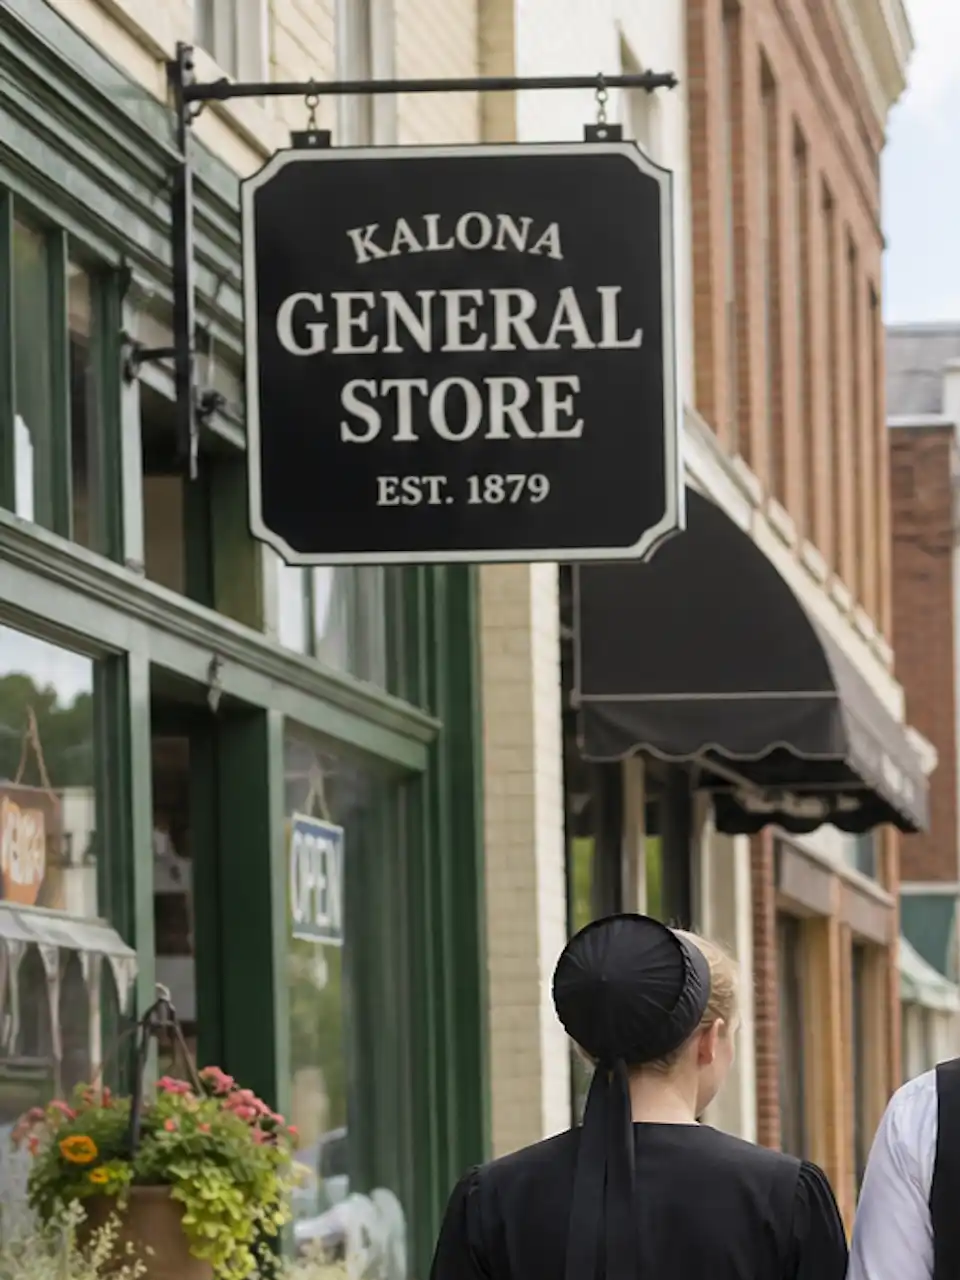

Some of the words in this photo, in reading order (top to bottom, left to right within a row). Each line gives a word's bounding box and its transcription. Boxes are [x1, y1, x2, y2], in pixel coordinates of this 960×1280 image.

[346, 211, 564, 264] KALONA
[276, 285, 643, 356] GENERAL
[340, 374, 585, 444] STORE
[376, 475, 454, 506] EST.
[467, 474, 550, 505] 1879
[290, 829, 341, 929] OPEN
